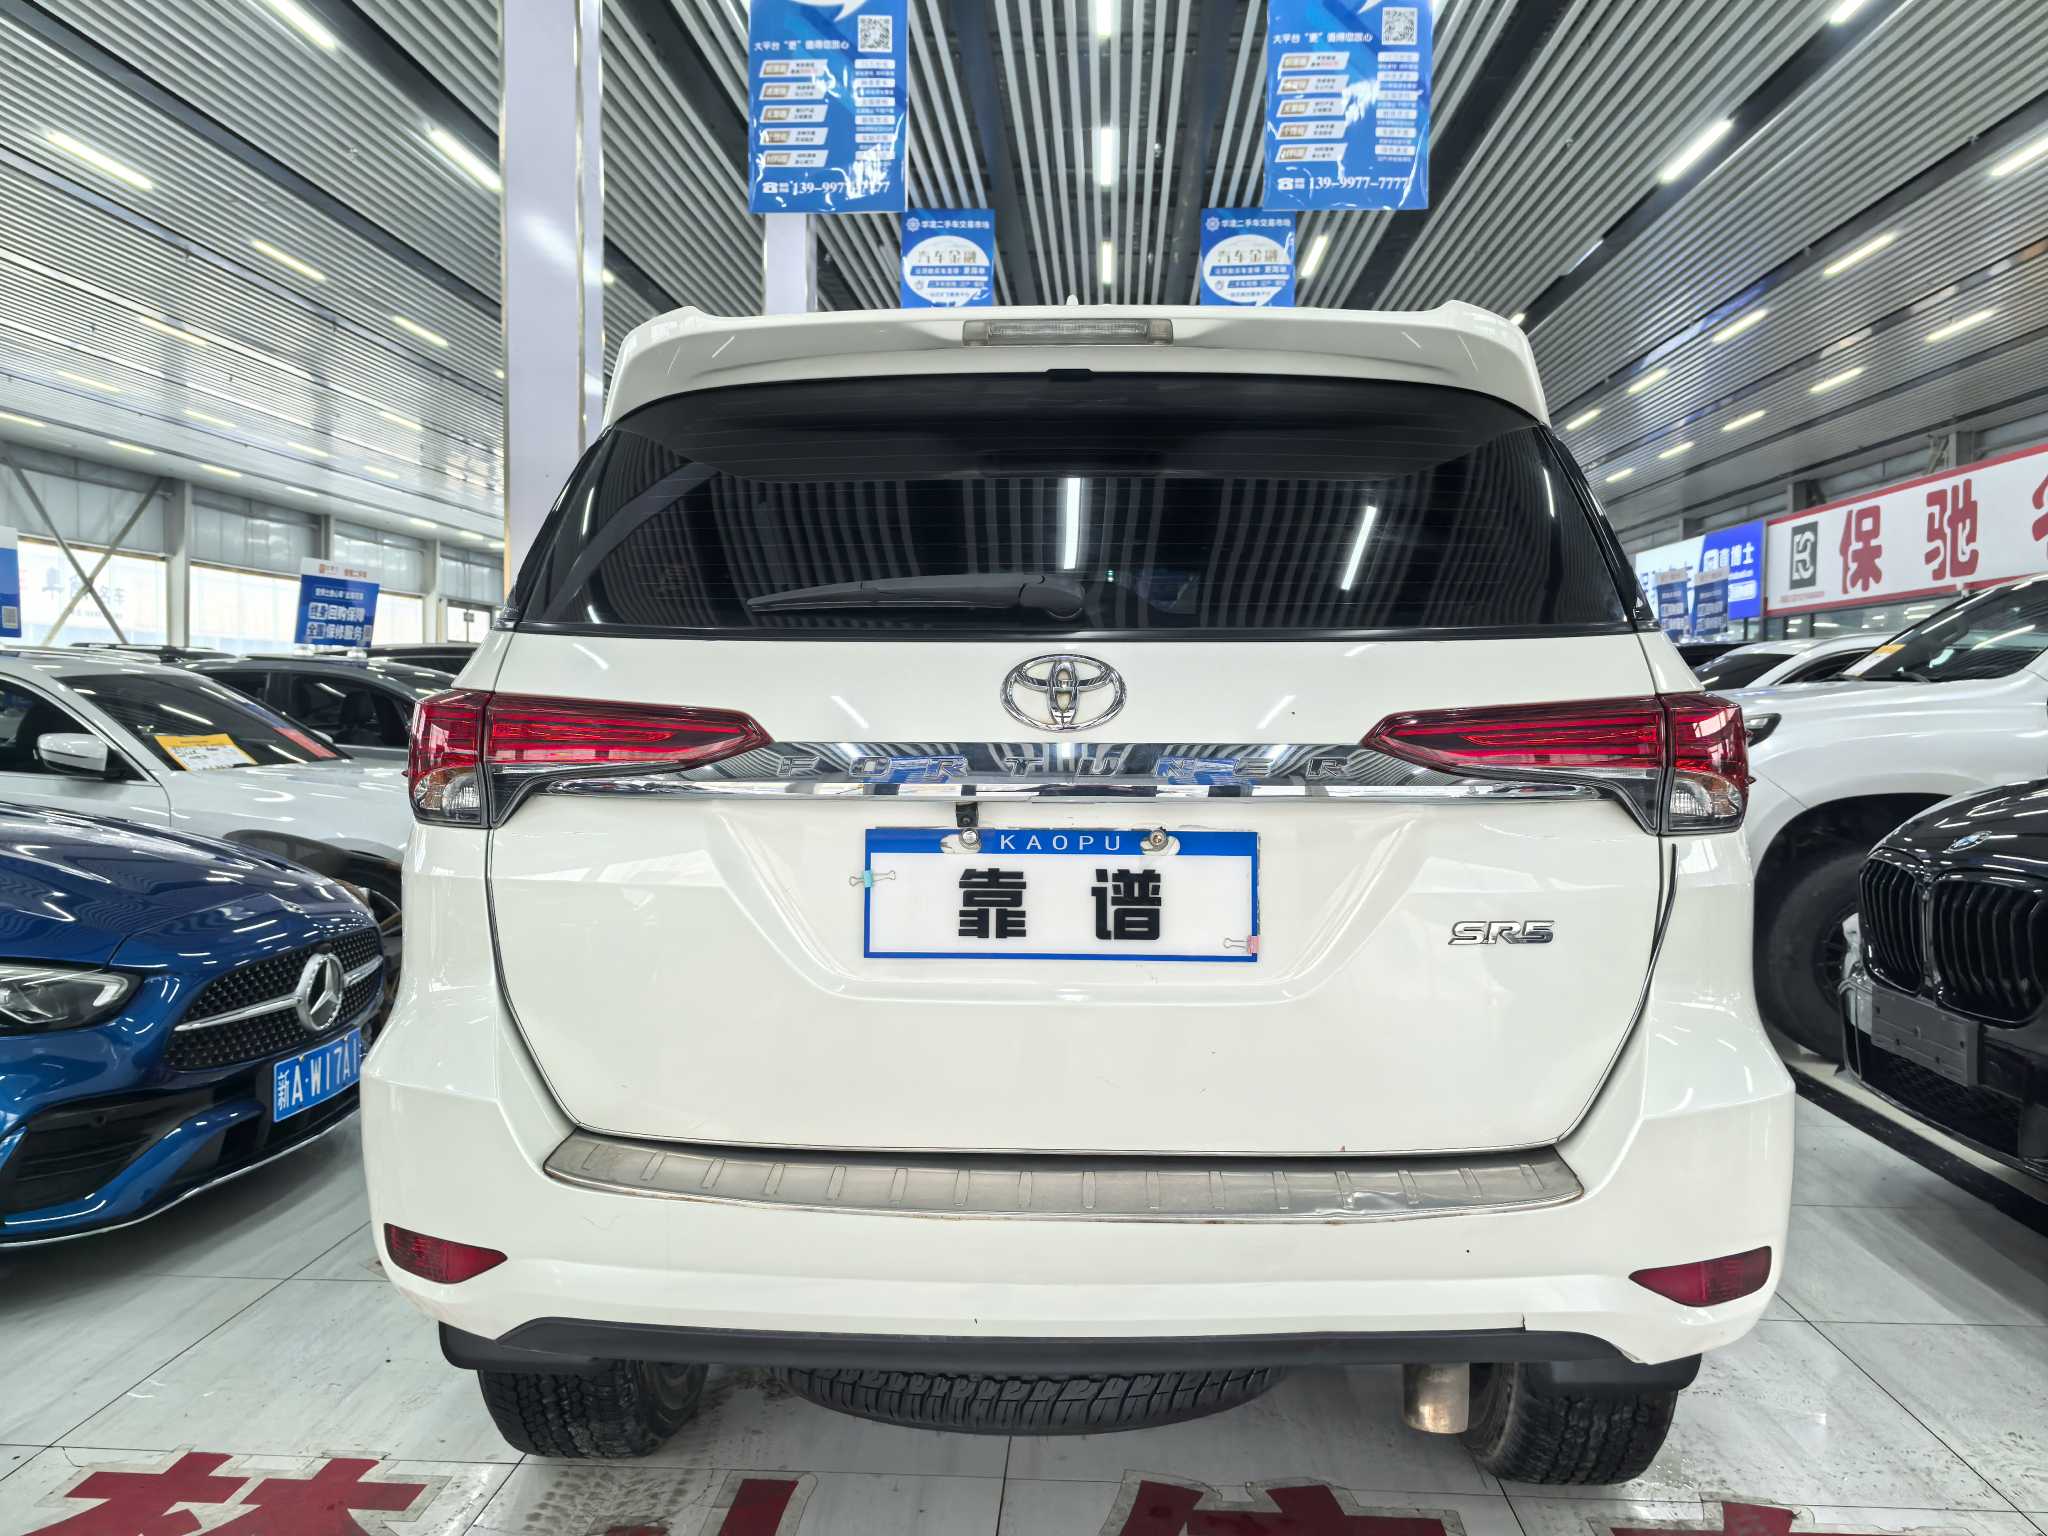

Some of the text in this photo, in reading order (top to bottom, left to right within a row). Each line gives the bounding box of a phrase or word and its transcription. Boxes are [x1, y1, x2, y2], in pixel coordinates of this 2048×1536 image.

[917, 249, 977, 264] 汽车金融
[1217, 249, 1278, 263] 汽车金融
[1840, 473, 2048, 595] 保驰
[776, 754, 1348, 778] FORTUNER
[1000, 834, 1121, 851] KAOPU
[958, 868, 1162, 940] 靠谱
[1447, 920, 1555, 945] SR5
